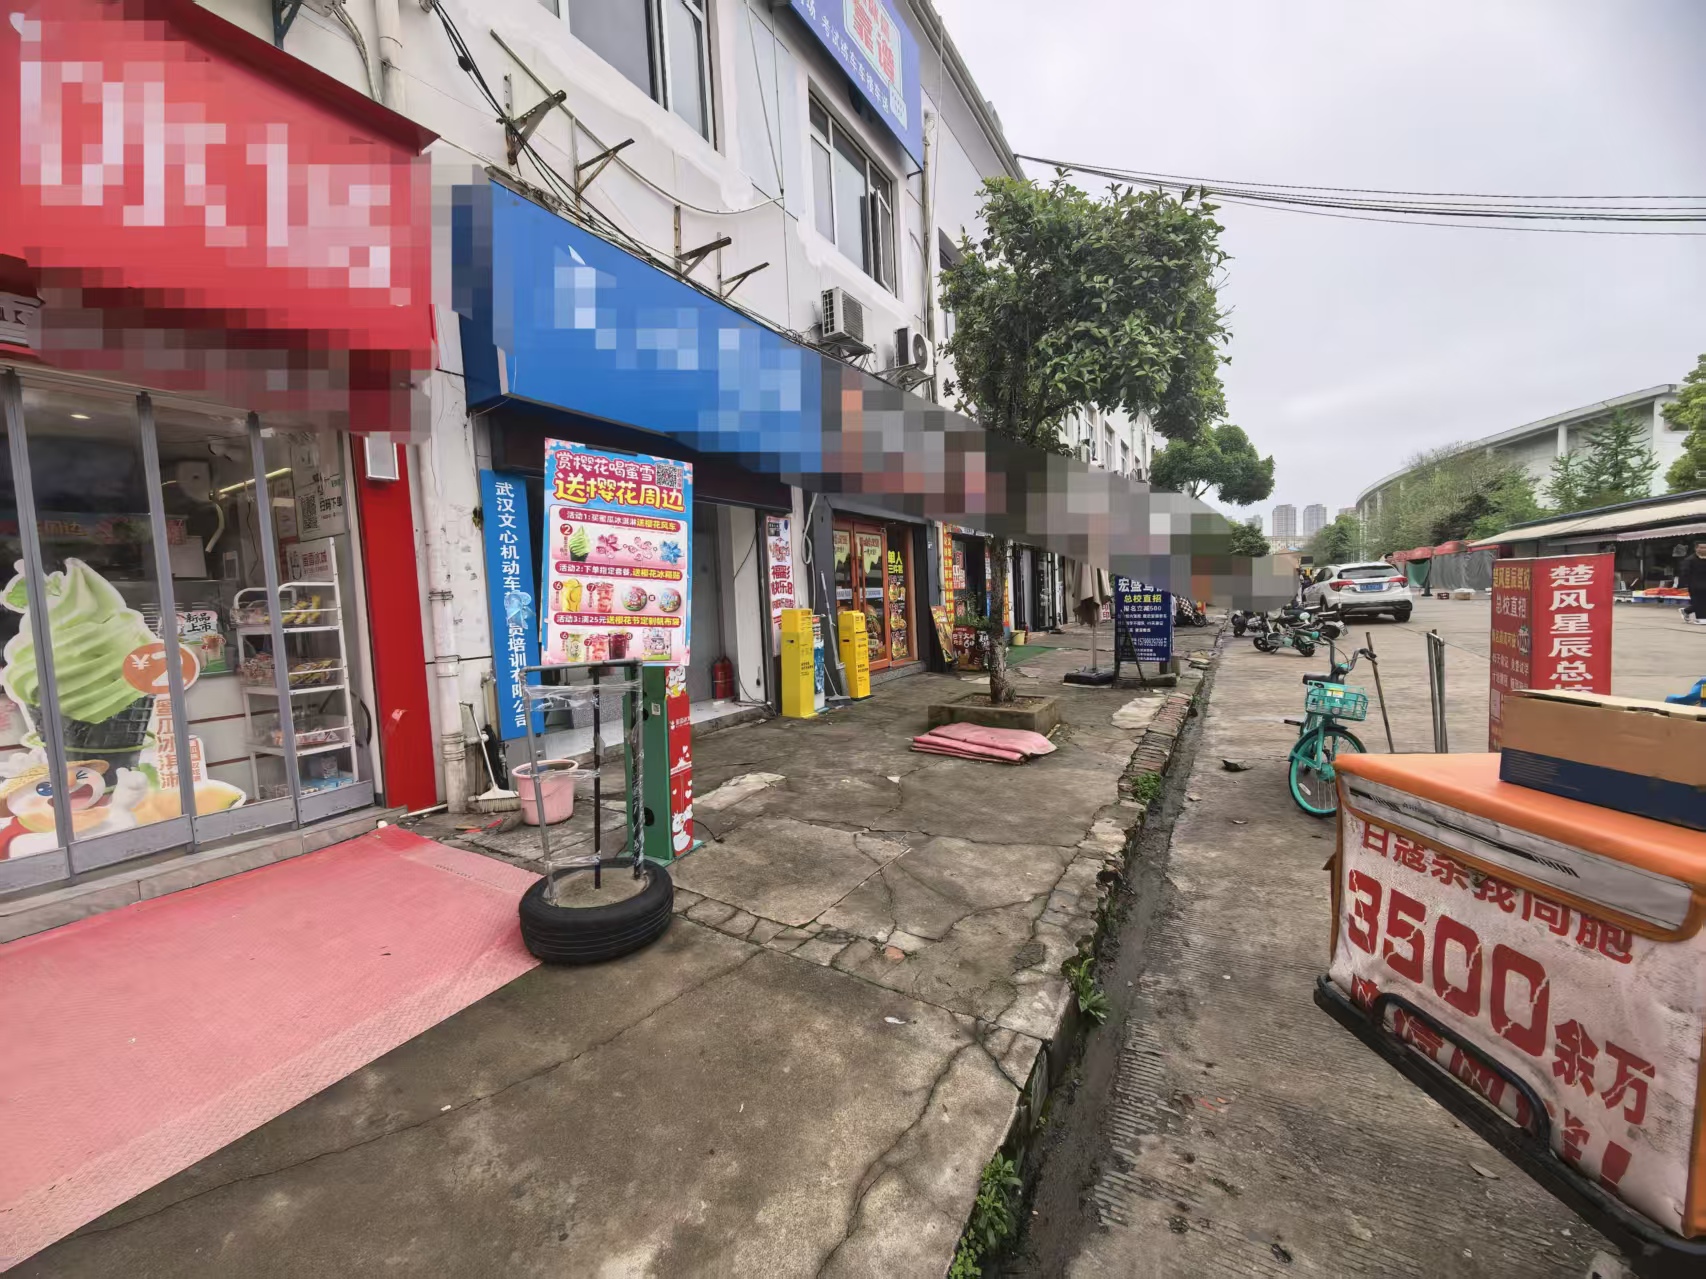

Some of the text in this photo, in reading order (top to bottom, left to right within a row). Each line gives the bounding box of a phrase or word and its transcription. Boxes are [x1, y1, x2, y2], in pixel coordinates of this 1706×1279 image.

[556, 451, 655, 482] 赏樱花喝蜜雪
[555, 472, 685, 511] 送樱花周边
[320, 496, 343, 512] 扫码下单
[887, 550, 903, 565] 单人
[1118, 578, 1163, 592] 宏盛
[494, 481, 528, 729] 武汉文心机动车员培训有限公司
[1124, 594, 1162, 603] 总校直招
[1496, 595, 1527, 618] 总校直招
[185, 613, 211, 623] 新品
[187, 622, 213, 633] 上市
